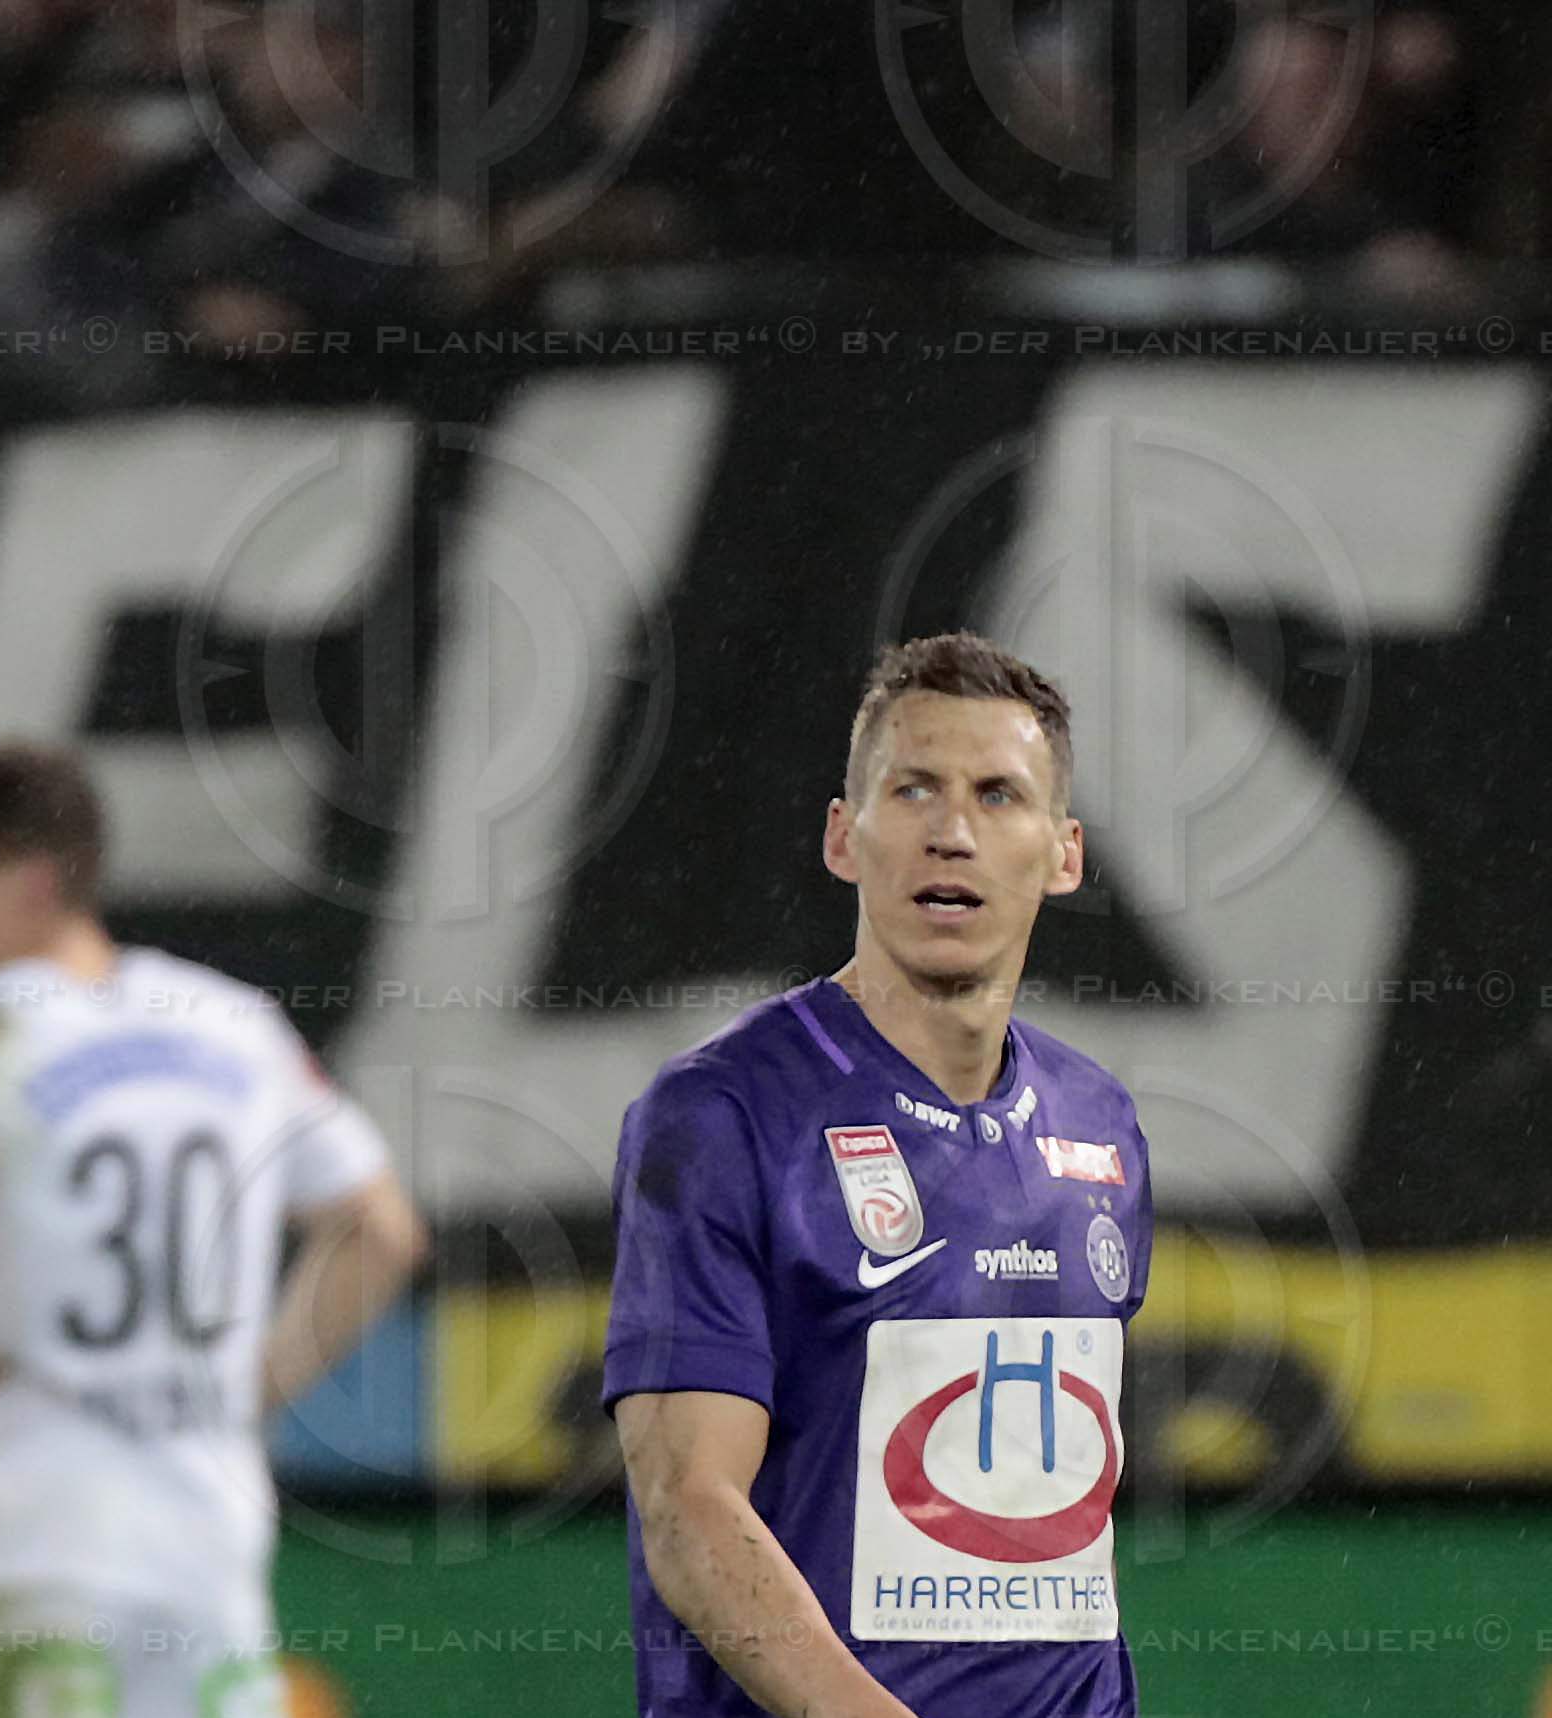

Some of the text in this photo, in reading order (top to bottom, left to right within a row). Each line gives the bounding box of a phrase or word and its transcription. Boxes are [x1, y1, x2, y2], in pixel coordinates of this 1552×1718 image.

[59, 1129, 238, 1350] 30
[974, 1239, 1058, 1280] synthos
[874, 1575, 1109, 1611] HARREITHER
